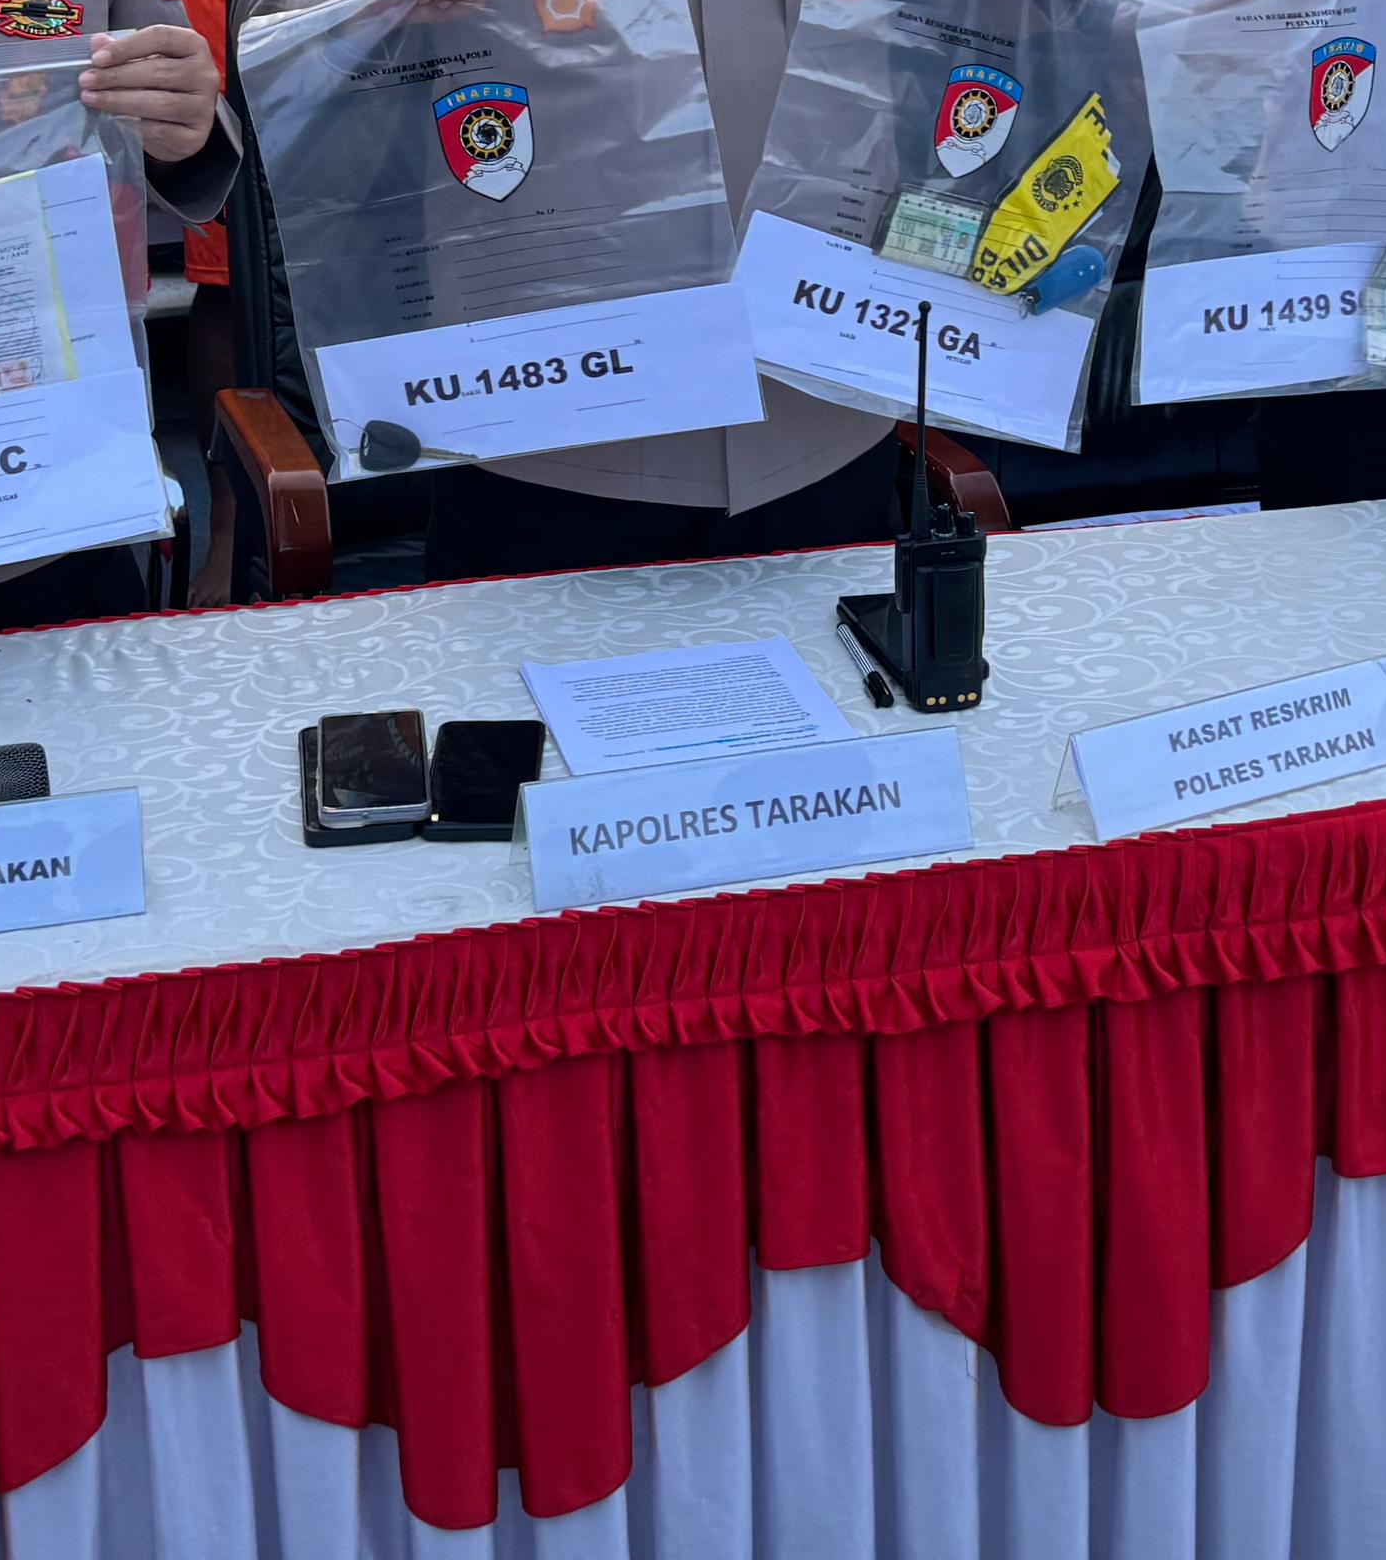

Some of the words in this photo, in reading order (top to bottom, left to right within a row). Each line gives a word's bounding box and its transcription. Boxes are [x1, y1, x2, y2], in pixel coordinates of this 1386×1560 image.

[446, 87, 513, 108] INAFIS
[793, 279, 845, 315] KU
[937, 324, 981, 360] GA
[1203, 304, 1248, 334] KU
[1260, 293, 1330, 326] 1439
[404, 374, 461, 406] KU
[476, 357, 568, 395] 1483
[581, 349, 634, 378] GL
[1169, 713, 1246, 753] KASAT
[1249, 686, 1352, 737] RESKRIM
[1174, 757, 1266, 803] POLRES
[1270, 728, 1375, 777] TARAKAN
[568, 800, 739, 858] KAPOLRES
[751, 780, 901, 832] TARAKAN
